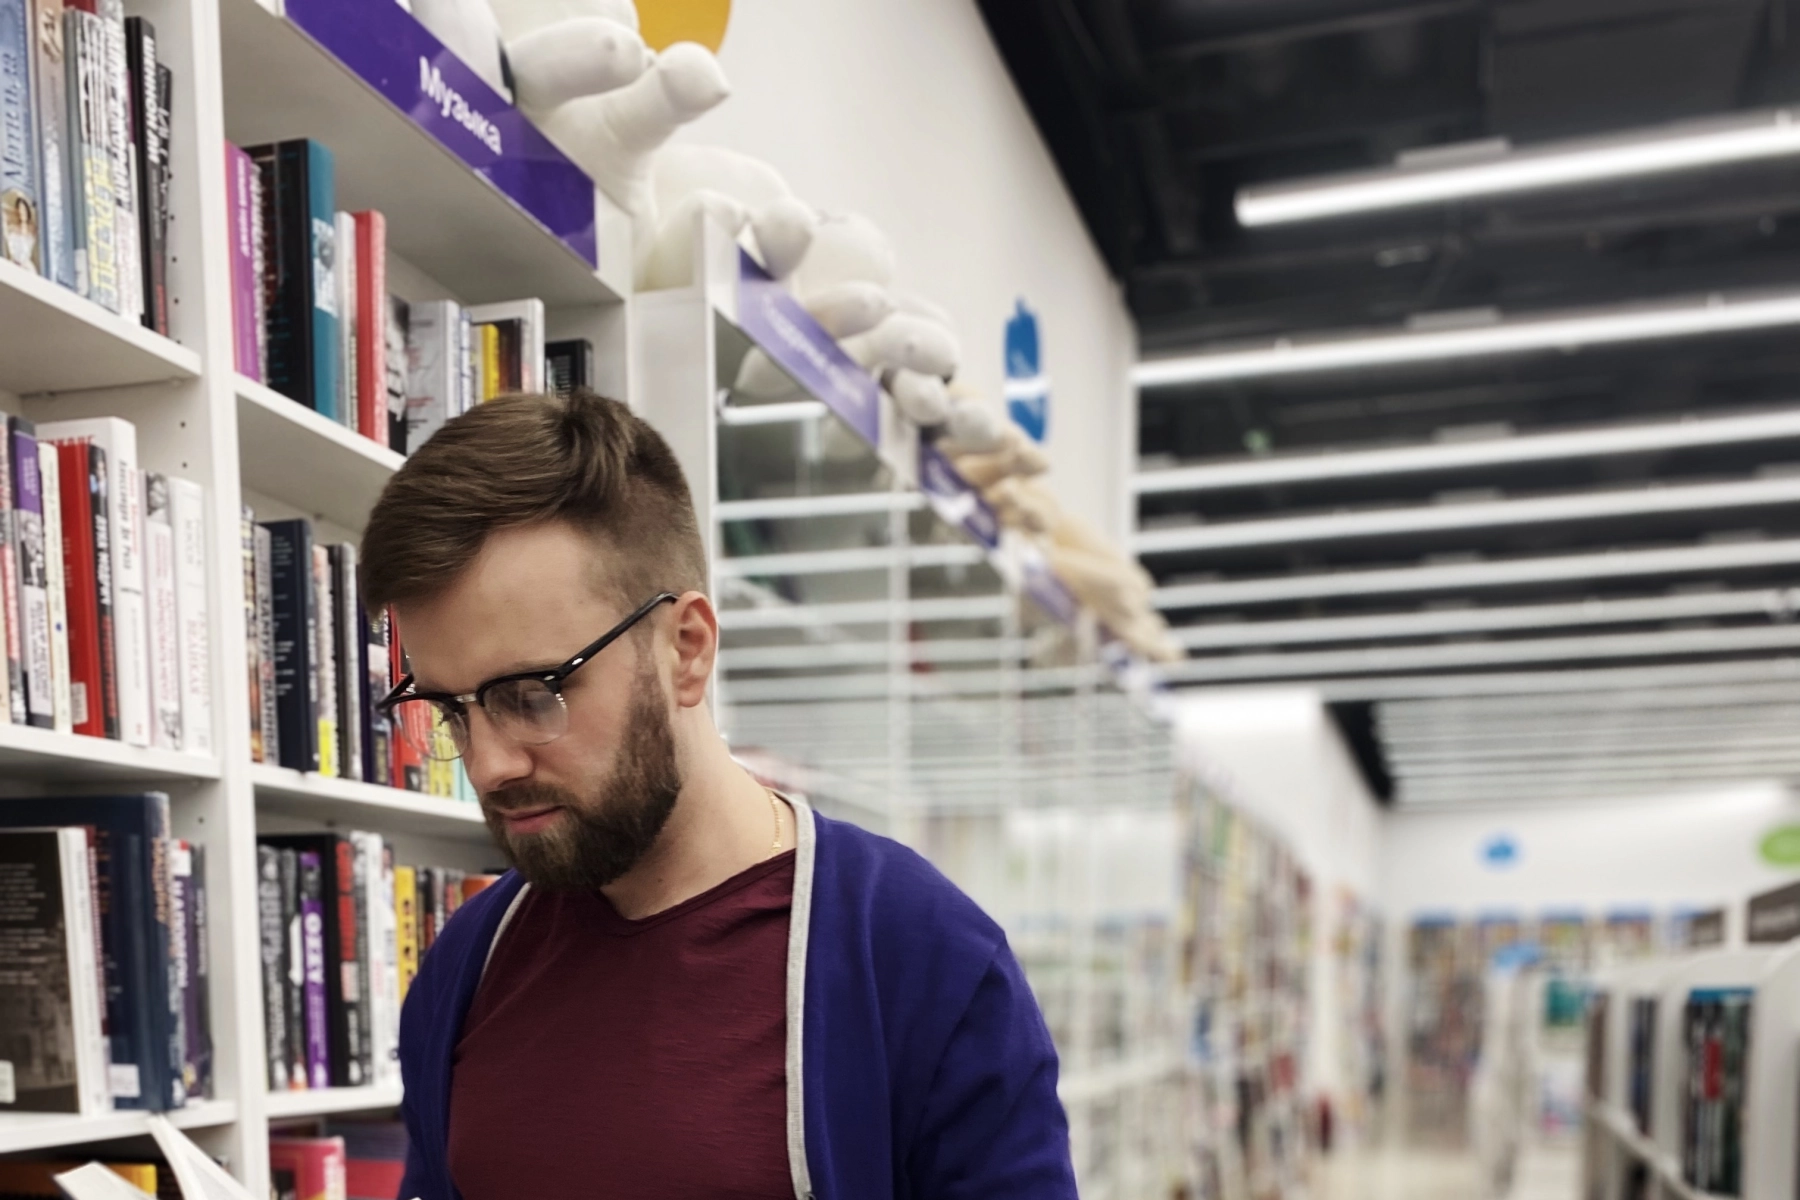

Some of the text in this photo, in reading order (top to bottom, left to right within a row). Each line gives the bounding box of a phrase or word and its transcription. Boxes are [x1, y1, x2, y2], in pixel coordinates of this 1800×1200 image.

[142, 35, 160, 163] ШЕННОН ЛИ
[419, 55, 503, 156] Музыка
[97, 550, 111, 606] МОДРИЧ
